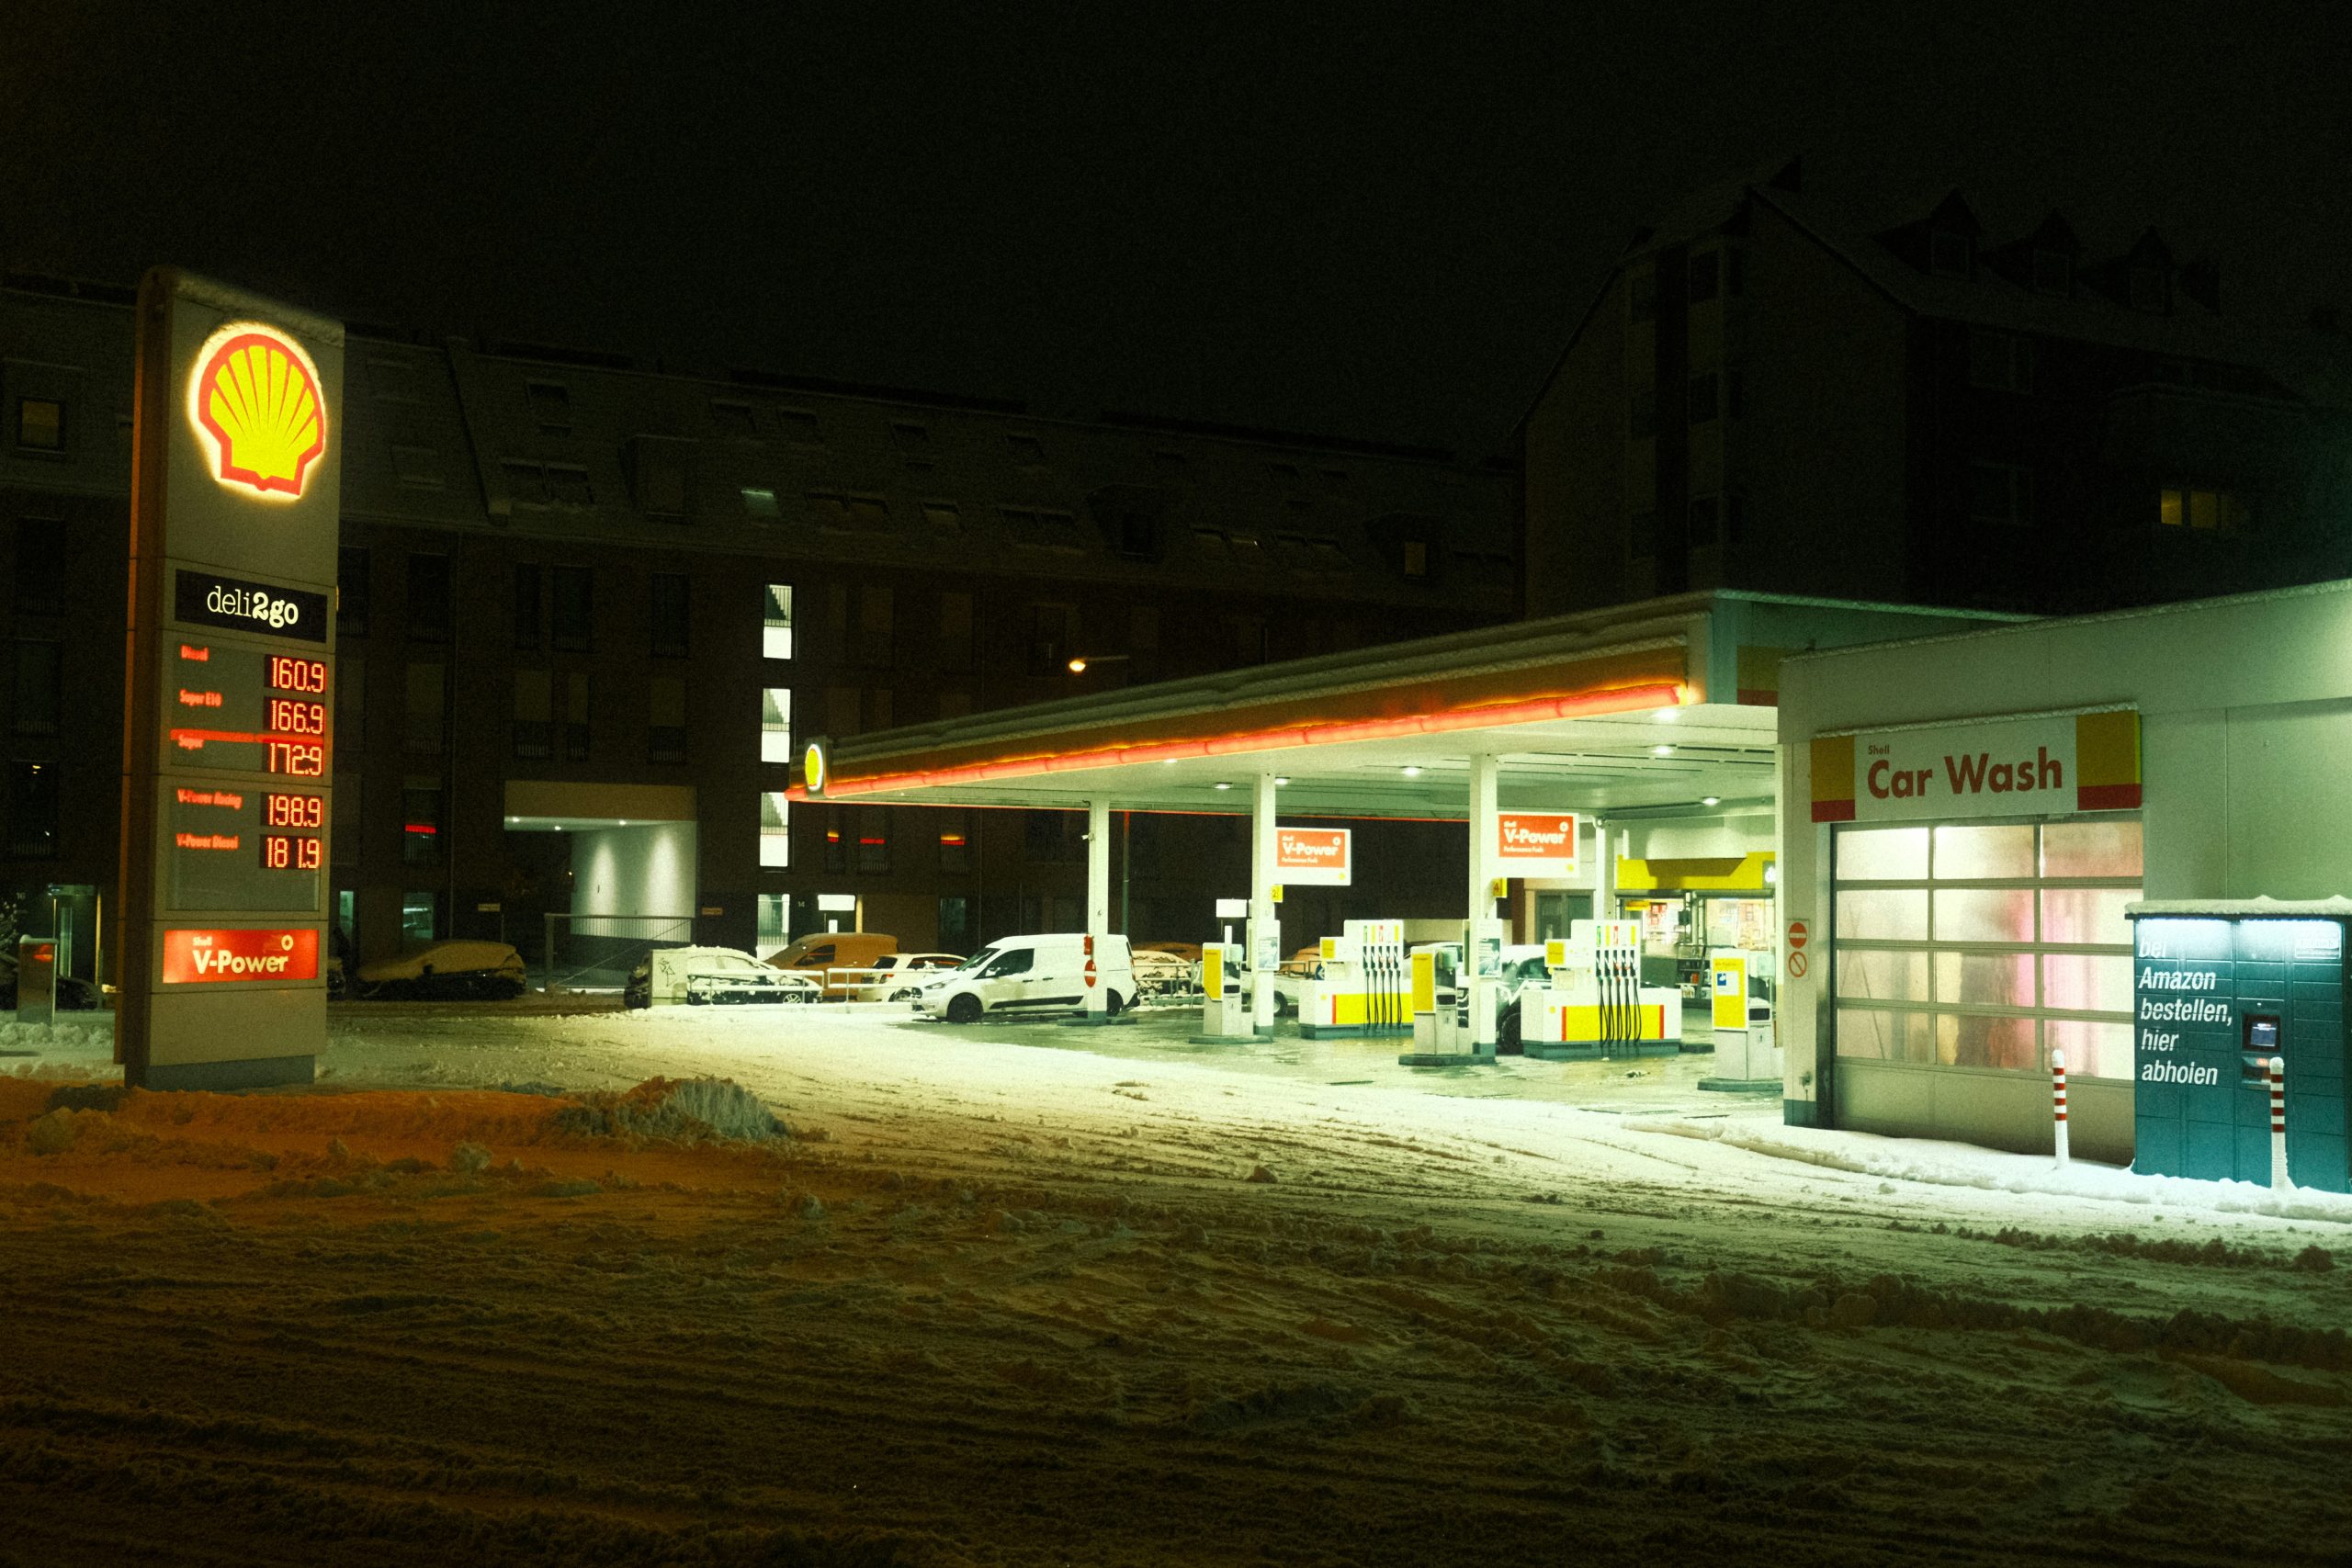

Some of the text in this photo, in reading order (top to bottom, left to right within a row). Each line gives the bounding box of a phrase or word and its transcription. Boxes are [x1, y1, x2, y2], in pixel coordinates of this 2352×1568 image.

[207, 585, 299, 628] deli2go
[1868, 745, 1890, 755] Shell
[1868, 746, 2063, 799] Car Wash
[1503, 829, 1566, 844] V-Power
[1282, 842, 1339, 856] V-Power
[192, 949, 288, 975] V-Power
[2138, 966, 2216, 990] Amazon
[2141, 998, 2233, 1027] bestellen,
[2141, 1028, 2179, 1052] hier
